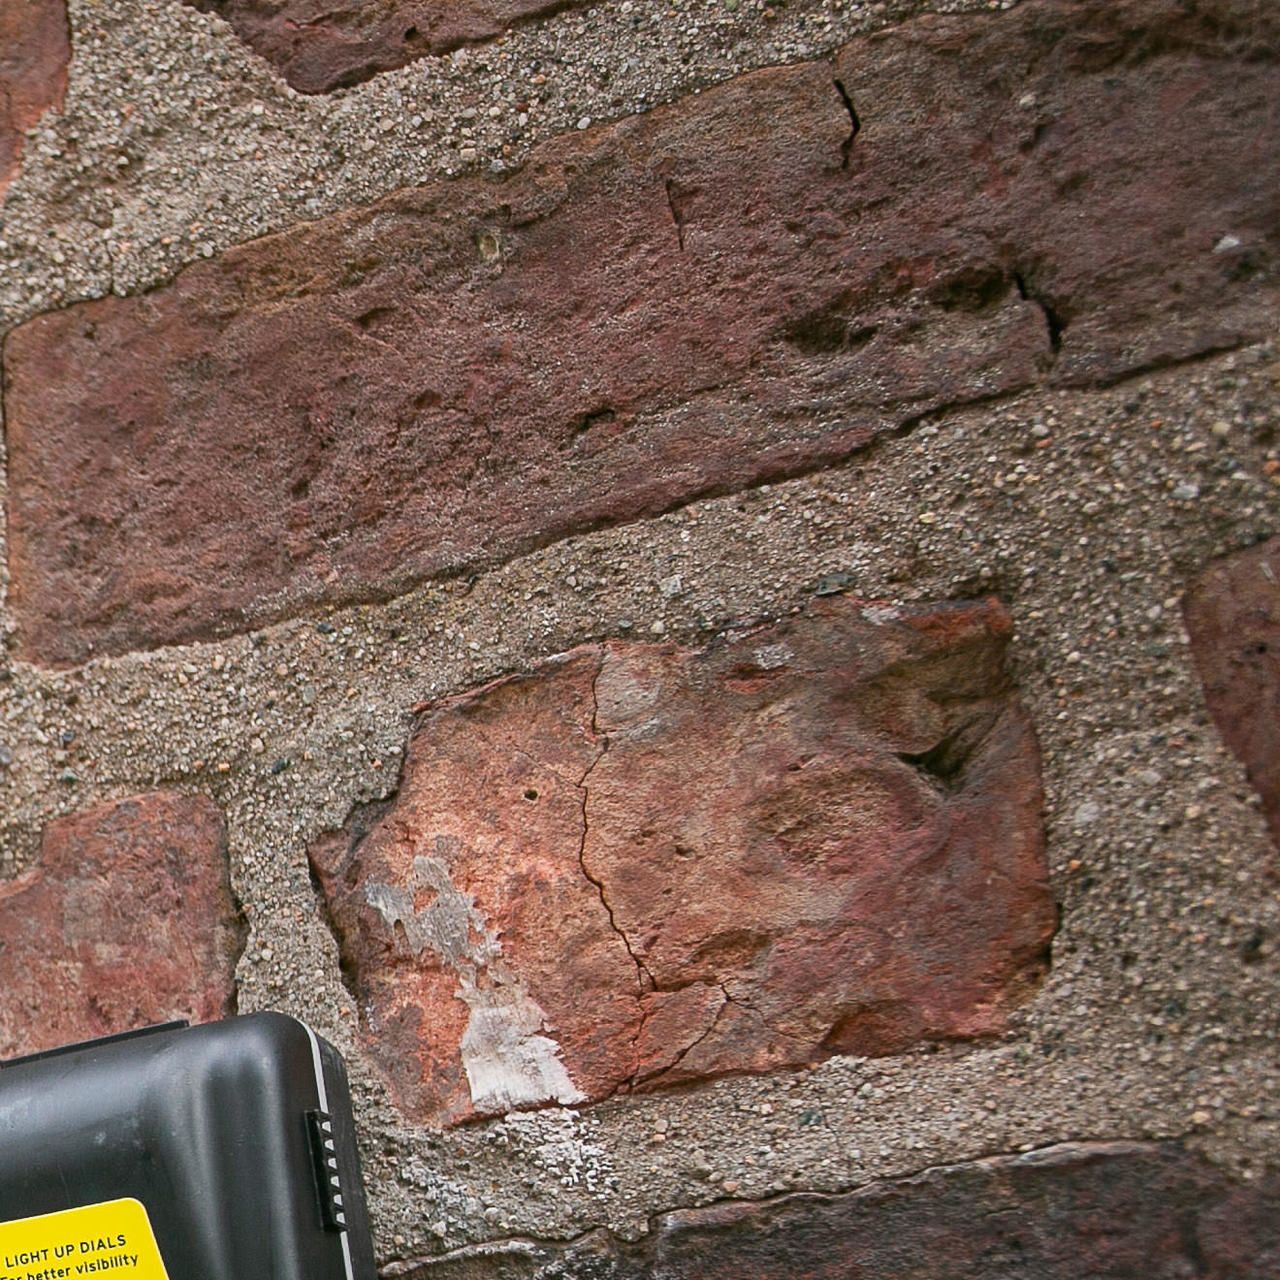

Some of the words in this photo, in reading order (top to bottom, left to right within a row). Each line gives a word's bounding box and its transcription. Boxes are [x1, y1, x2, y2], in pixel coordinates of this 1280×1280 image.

[5, 1249, 49, 1268] LIGHT
[54, 1244, 75, 1258] UP
[80, 1234, 126, 1254] DIALS
[76, 1254, 138, 1274] visibility
